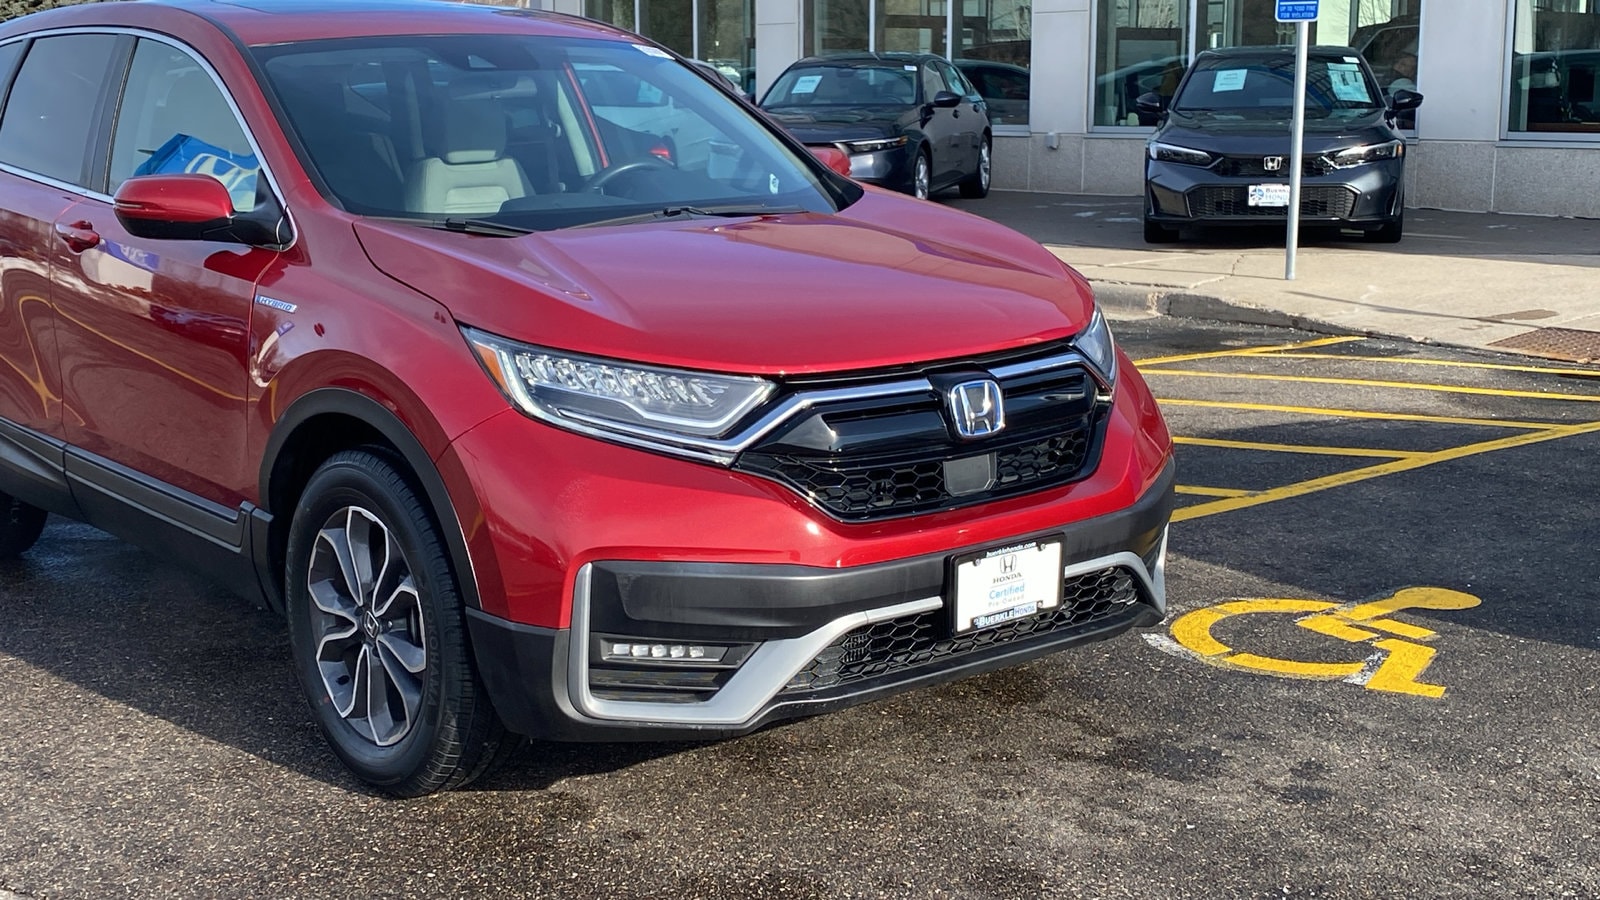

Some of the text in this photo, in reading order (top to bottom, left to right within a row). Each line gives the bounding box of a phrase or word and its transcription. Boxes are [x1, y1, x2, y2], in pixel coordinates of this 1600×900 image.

[261, 297, 292, 310] HYBRID
[993, 572, 1022, 583] HONDA
[989, 583, 1025, 599] Certified
[979, 605, 1035, 625] BUERKLE HONDA
